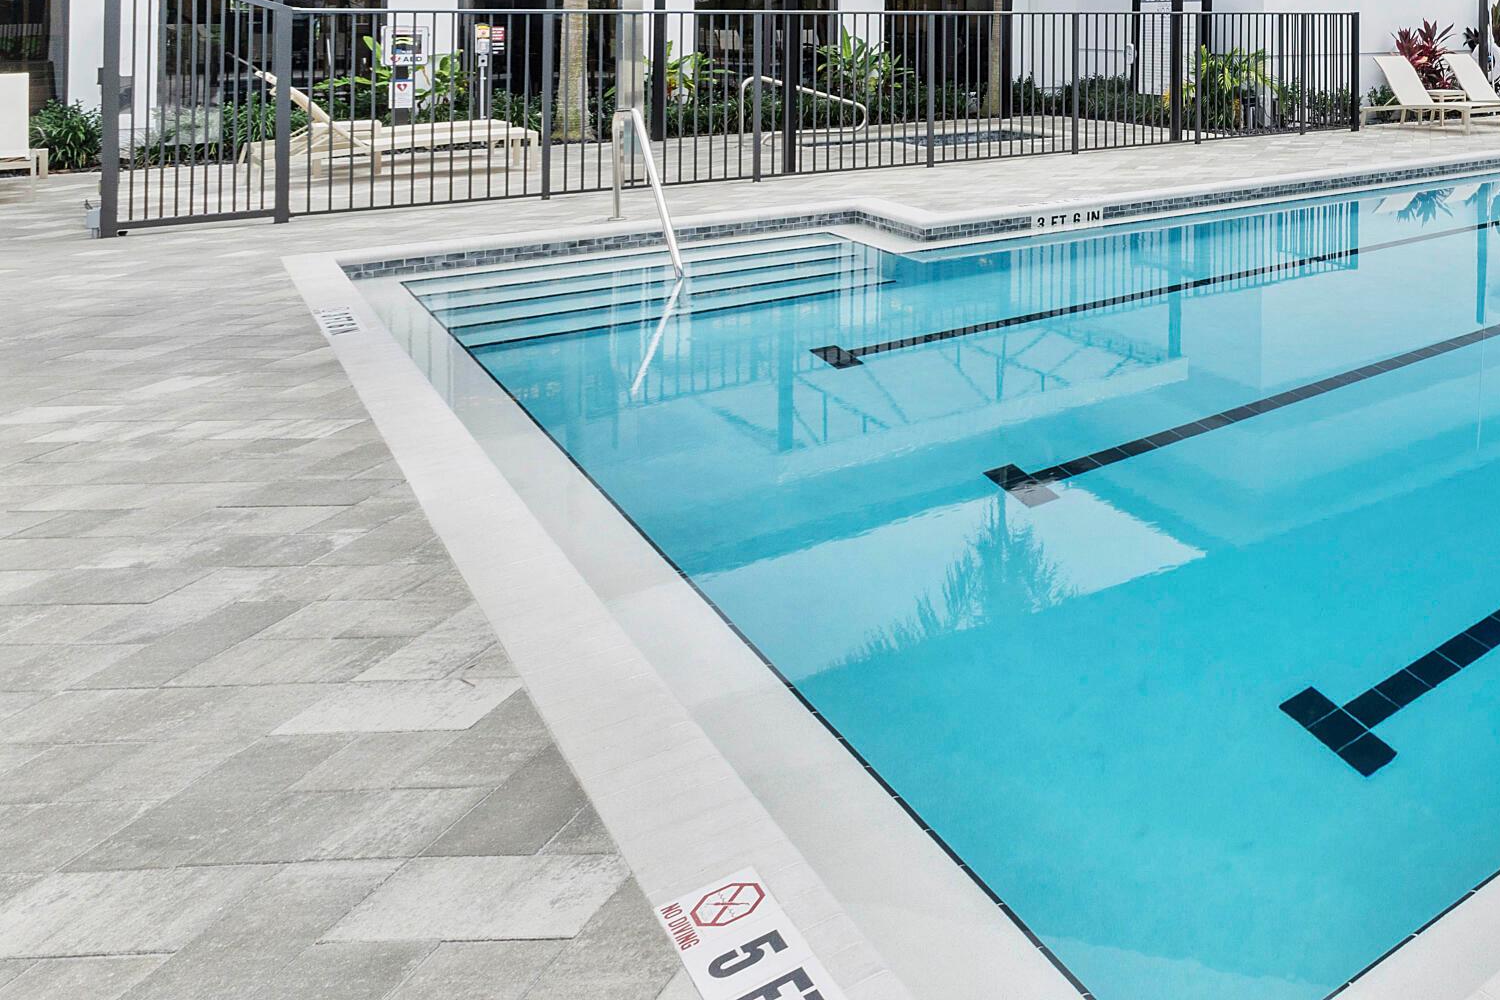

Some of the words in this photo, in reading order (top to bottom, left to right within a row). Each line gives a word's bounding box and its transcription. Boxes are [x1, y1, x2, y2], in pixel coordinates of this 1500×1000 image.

[1037, 216, 1045, 228] 3
[1051, 214, 1067, 226] FT
[1086, 210, 1100, 222] IN
[660, 902, 682, 919] NO
[668, 916, 700, 950] DIVING
[708, 929, 789, 979] 5
[736, 966, 825, 1000] F
